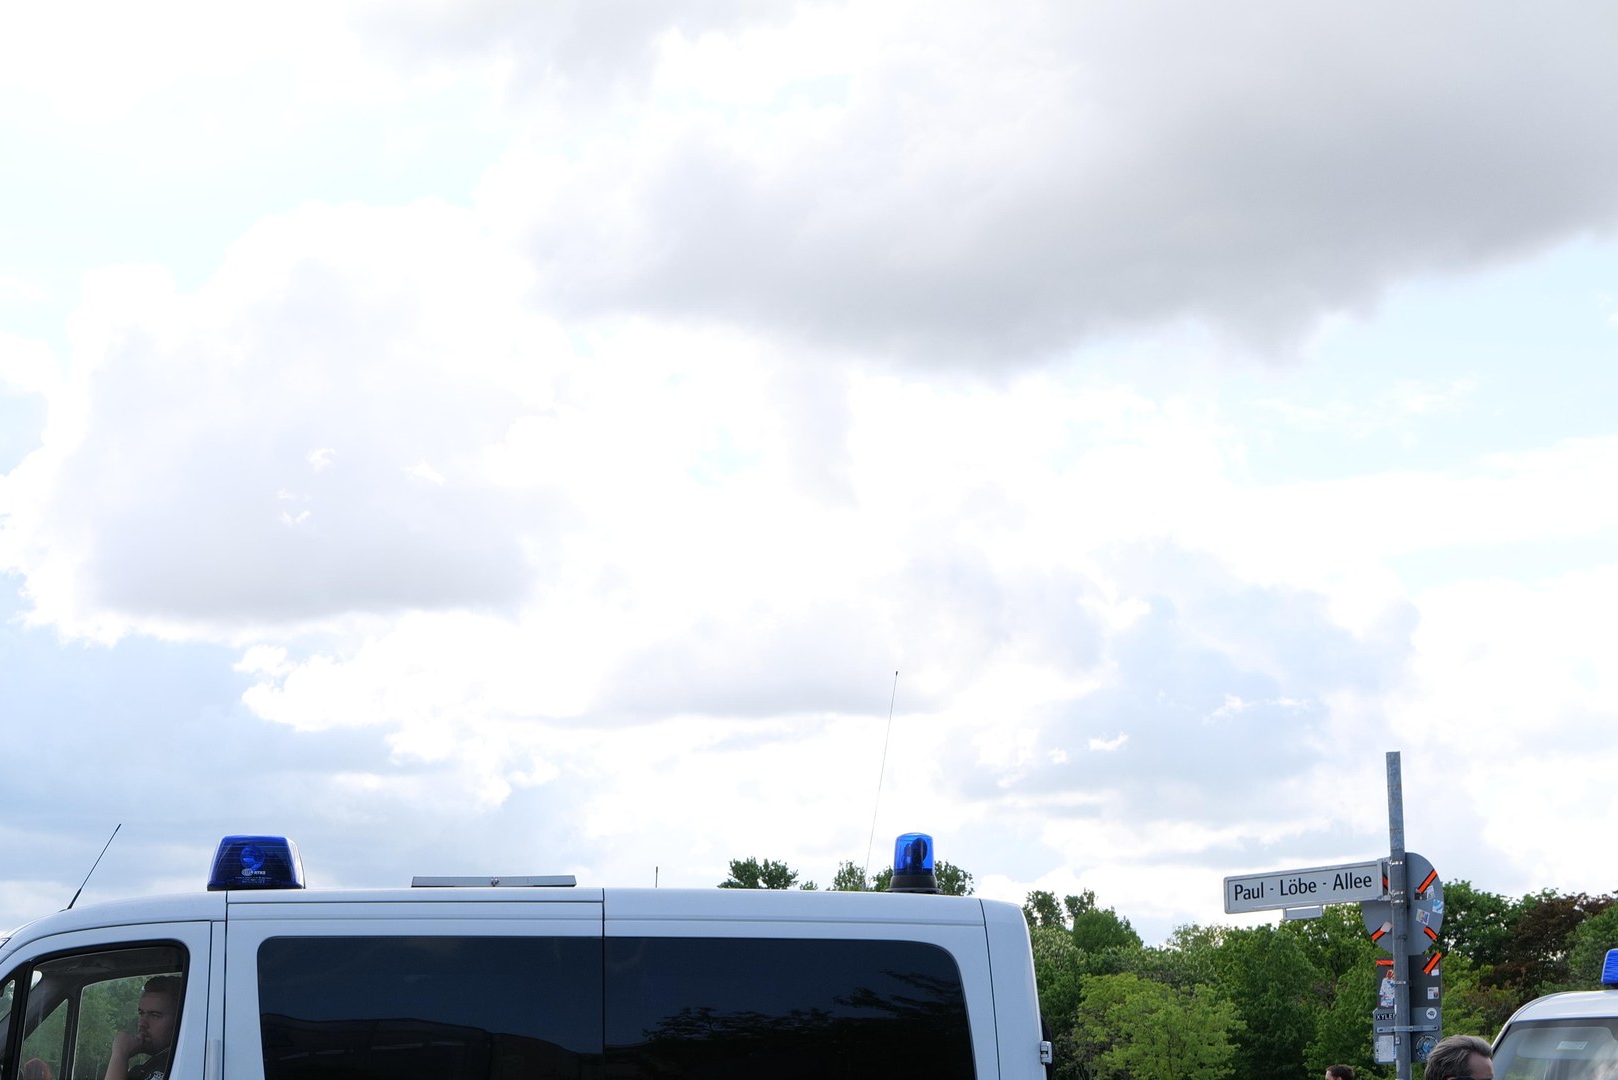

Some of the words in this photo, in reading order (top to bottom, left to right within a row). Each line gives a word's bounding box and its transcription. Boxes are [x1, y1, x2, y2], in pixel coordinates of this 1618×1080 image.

[1234, 882, 1265, 901] Paul
[1280, 877, 1317, 896] Löbe
[1333, 872, 1372, 891] Allee
